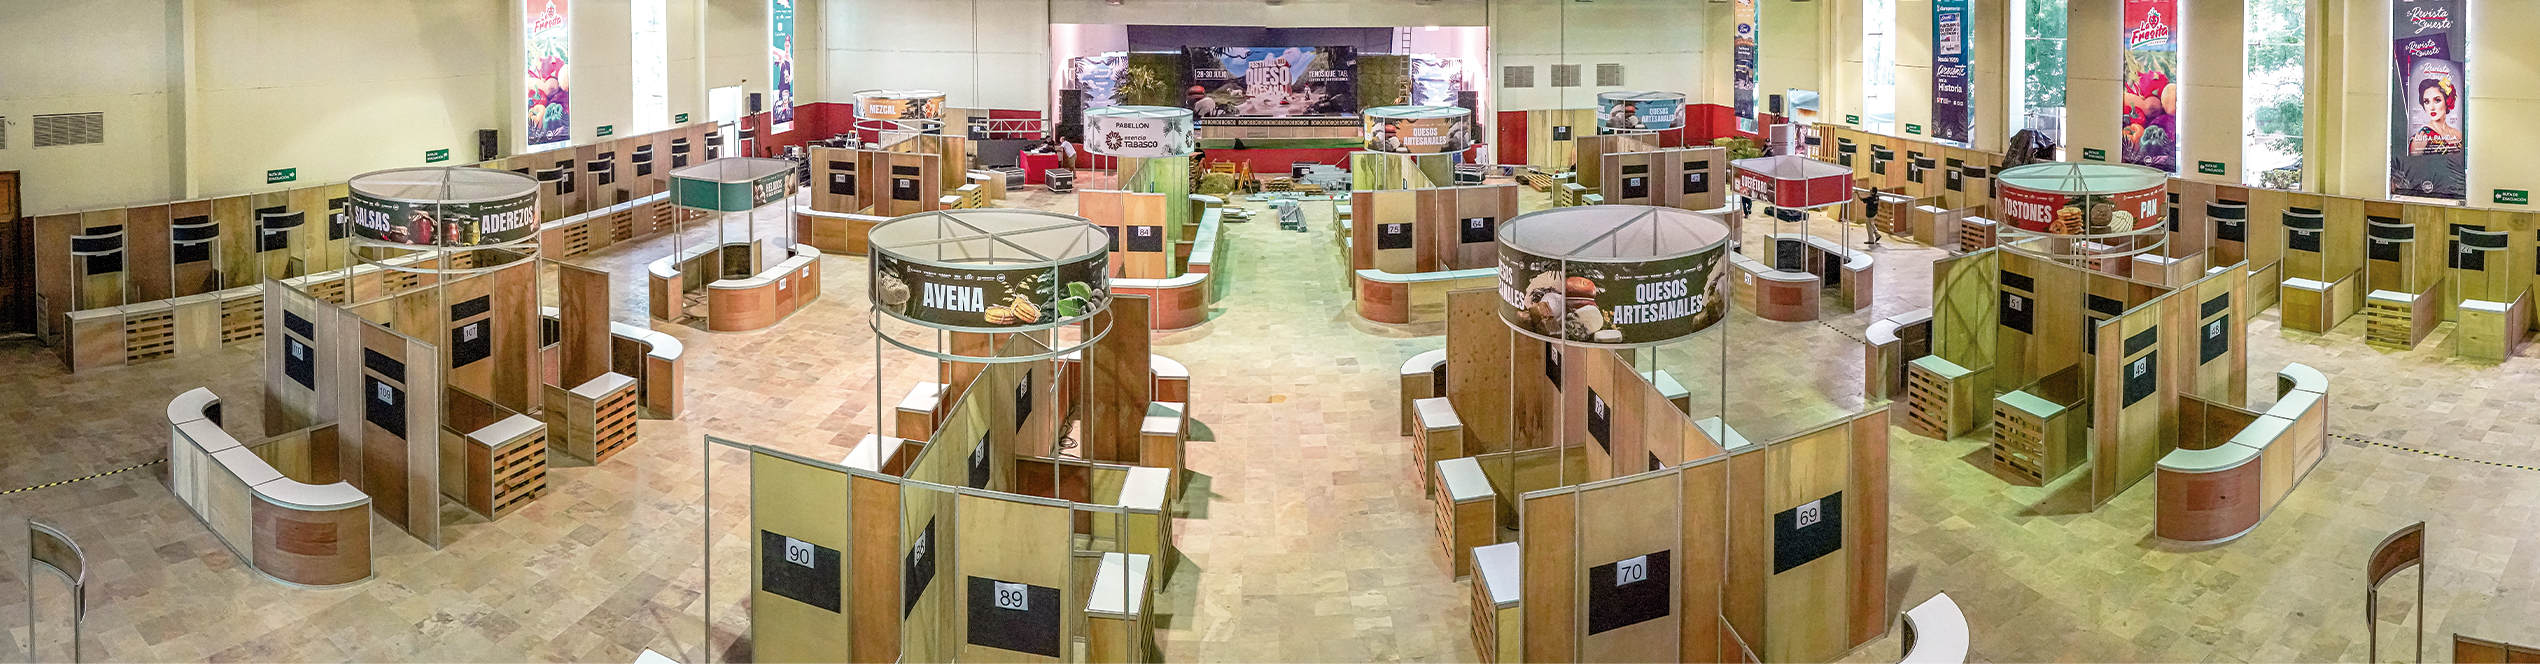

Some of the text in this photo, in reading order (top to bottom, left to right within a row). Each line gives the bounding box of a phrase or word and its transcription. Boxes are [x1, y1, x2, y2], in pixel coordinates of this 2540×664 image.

[2410, 6, 2448, 21] Revista
[2131, 25, 2168, 44] Fresita
[1249, 60, 1276, 68] FESTIVAL
[1213, 70, 1227, 78] JULIO
[1246, 66, 1290, 86] QUESO
[1246, 85, 1290, 96] ARTESANAL
[1938, 83, 1963, 93] Historia
[869, 104, 897, 115] MEZCAL
[1649, 107, 1669, 115] QUESOS
[1115, 121, 1150, 129] PABELLÓN
[1413, 128, 1438, 137] QUESOS
[1403, 136, 1447, 146] ARTESANALES
[2004, 197, 2157, 224] TOSTONES PAN
[354, 205, 533, 234] SALSAS ADEREZOS
[1472, 220, 1482, 228] 64
[1139, 228, 1149, 236] 84
[923, 282, 985, 313] AVENA
[1635, 277, 1688, 304] QUESOS
[1613, 293, 1703, 325] ARTESANALES
[2011, 298, 2020, 308] 51
[292, 343, 303, 357] 110
[2136, 362, 2145, 376] 49
[379, 385, 391, 400] 109
[1596, 400, 1603, 417] 72
[1800, 507, 1818, 526] 69
[789, 545, 810, 565] 90
[1621, 563, 1643, 583] 70
[1000, 589, 1023, 608] 89
